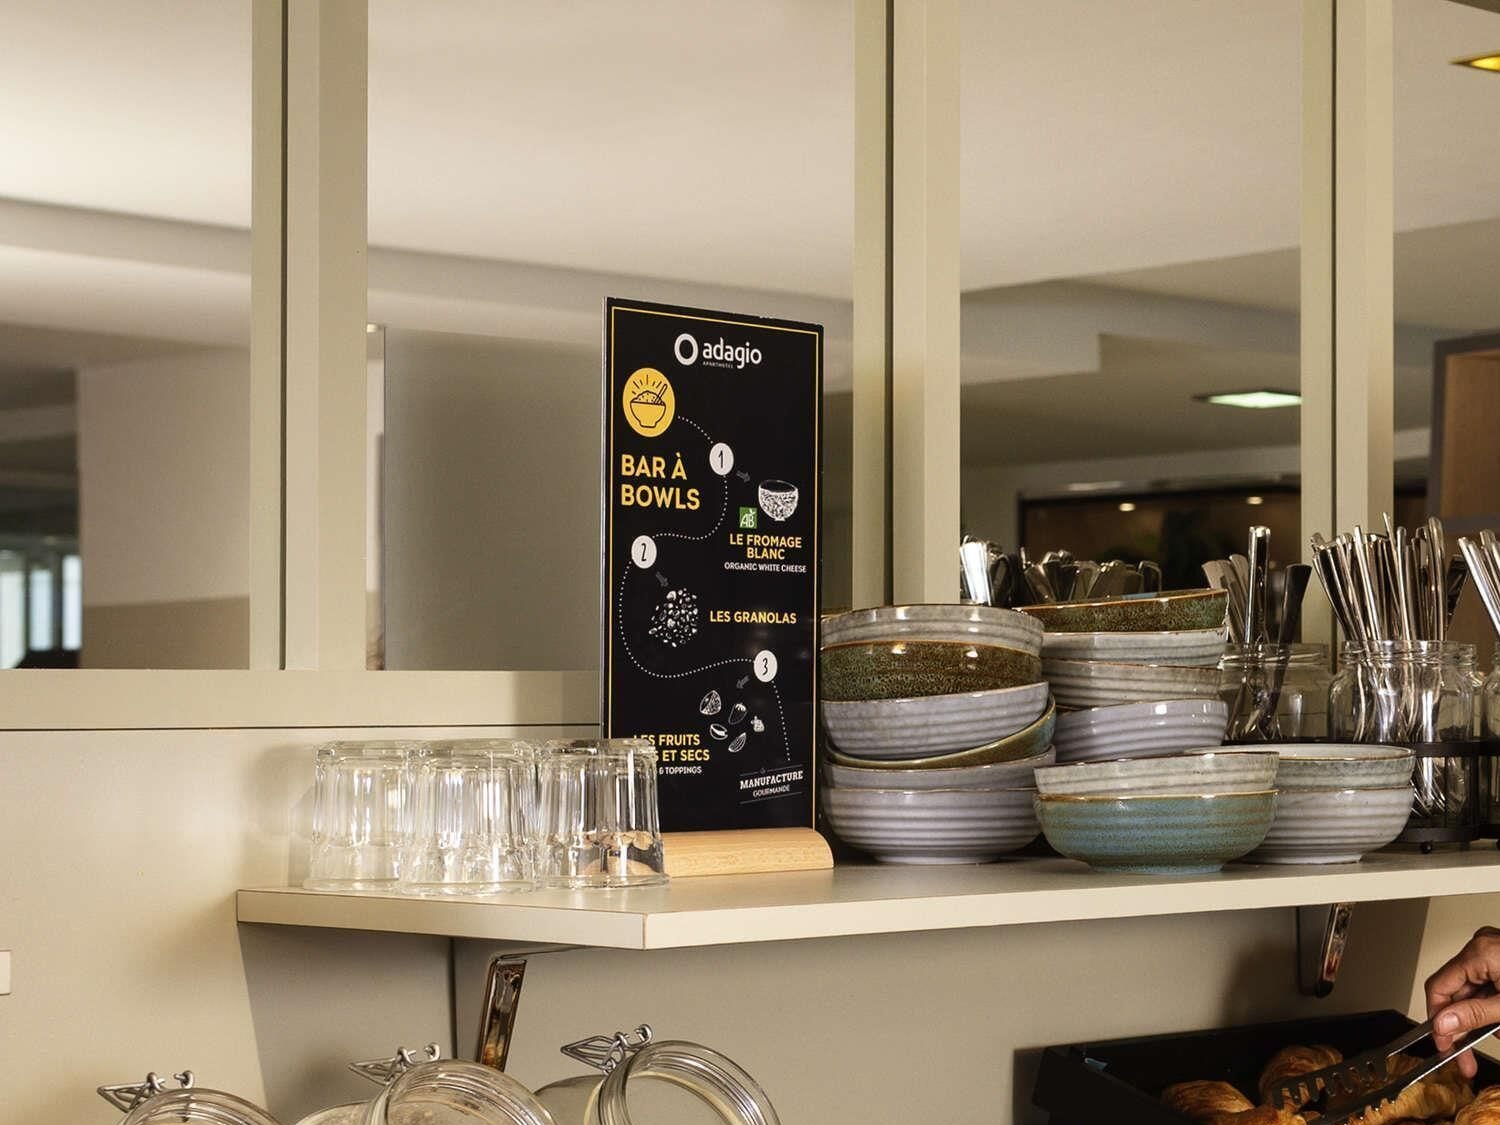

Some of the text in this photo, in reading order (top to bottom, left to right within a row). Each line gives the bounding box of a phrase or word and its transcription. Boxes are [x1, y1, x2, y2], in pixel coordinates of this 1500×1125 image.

[702, 336, 763, 369] adagio
[621, 452, 687, 481] BAR À
[620, 484, 700, 511] BOWLS
[729, 533, 802, 549] LE FROMAGE
[640, 542, 648, 562] 2
[746, 547, 785, 560] BLANC
[724, 561, 807, 573] ORGANIC WHITE CHEESE
[710, 610, 797, 624] LES GRANOLAS
[659, 734, 701, 746] FRUITS
[662, 749, 677, 762] ET
[680, 749, 710, 762] SECS
[665, 766, 703, 775] TOPPINGS
[740, 770, 803, 790] MANUFACTURE
[752, 784, 791, 798] GOURMANDE
